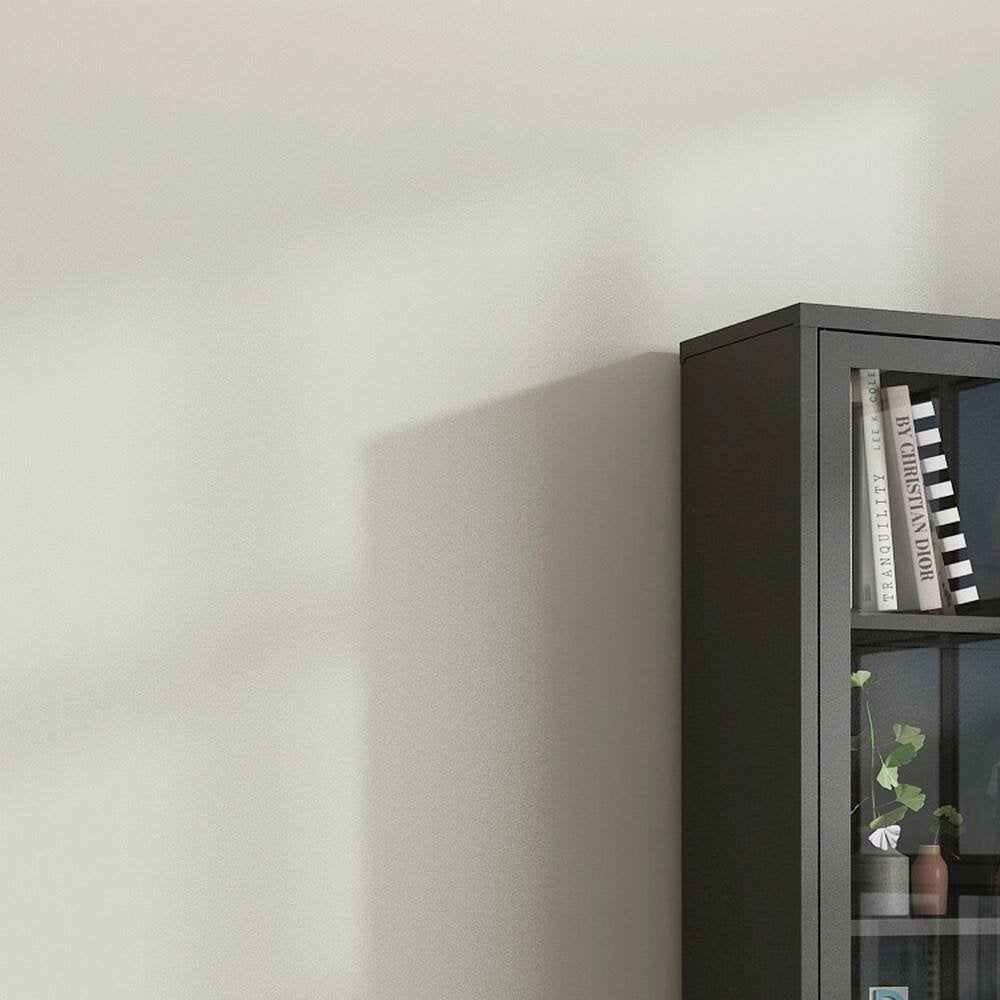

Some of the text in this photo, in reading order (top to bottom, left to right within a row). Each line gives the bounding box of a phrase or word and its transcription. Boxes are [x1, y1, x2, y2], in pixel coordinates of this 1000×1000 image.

[867, 371, 878, 404] COLE
[873, 428, 881, 451] LEE
[873, 474, 894, 602] TRANQUILITY
[895, 416, 935, 582] BY CHRISTIAN DIOR
